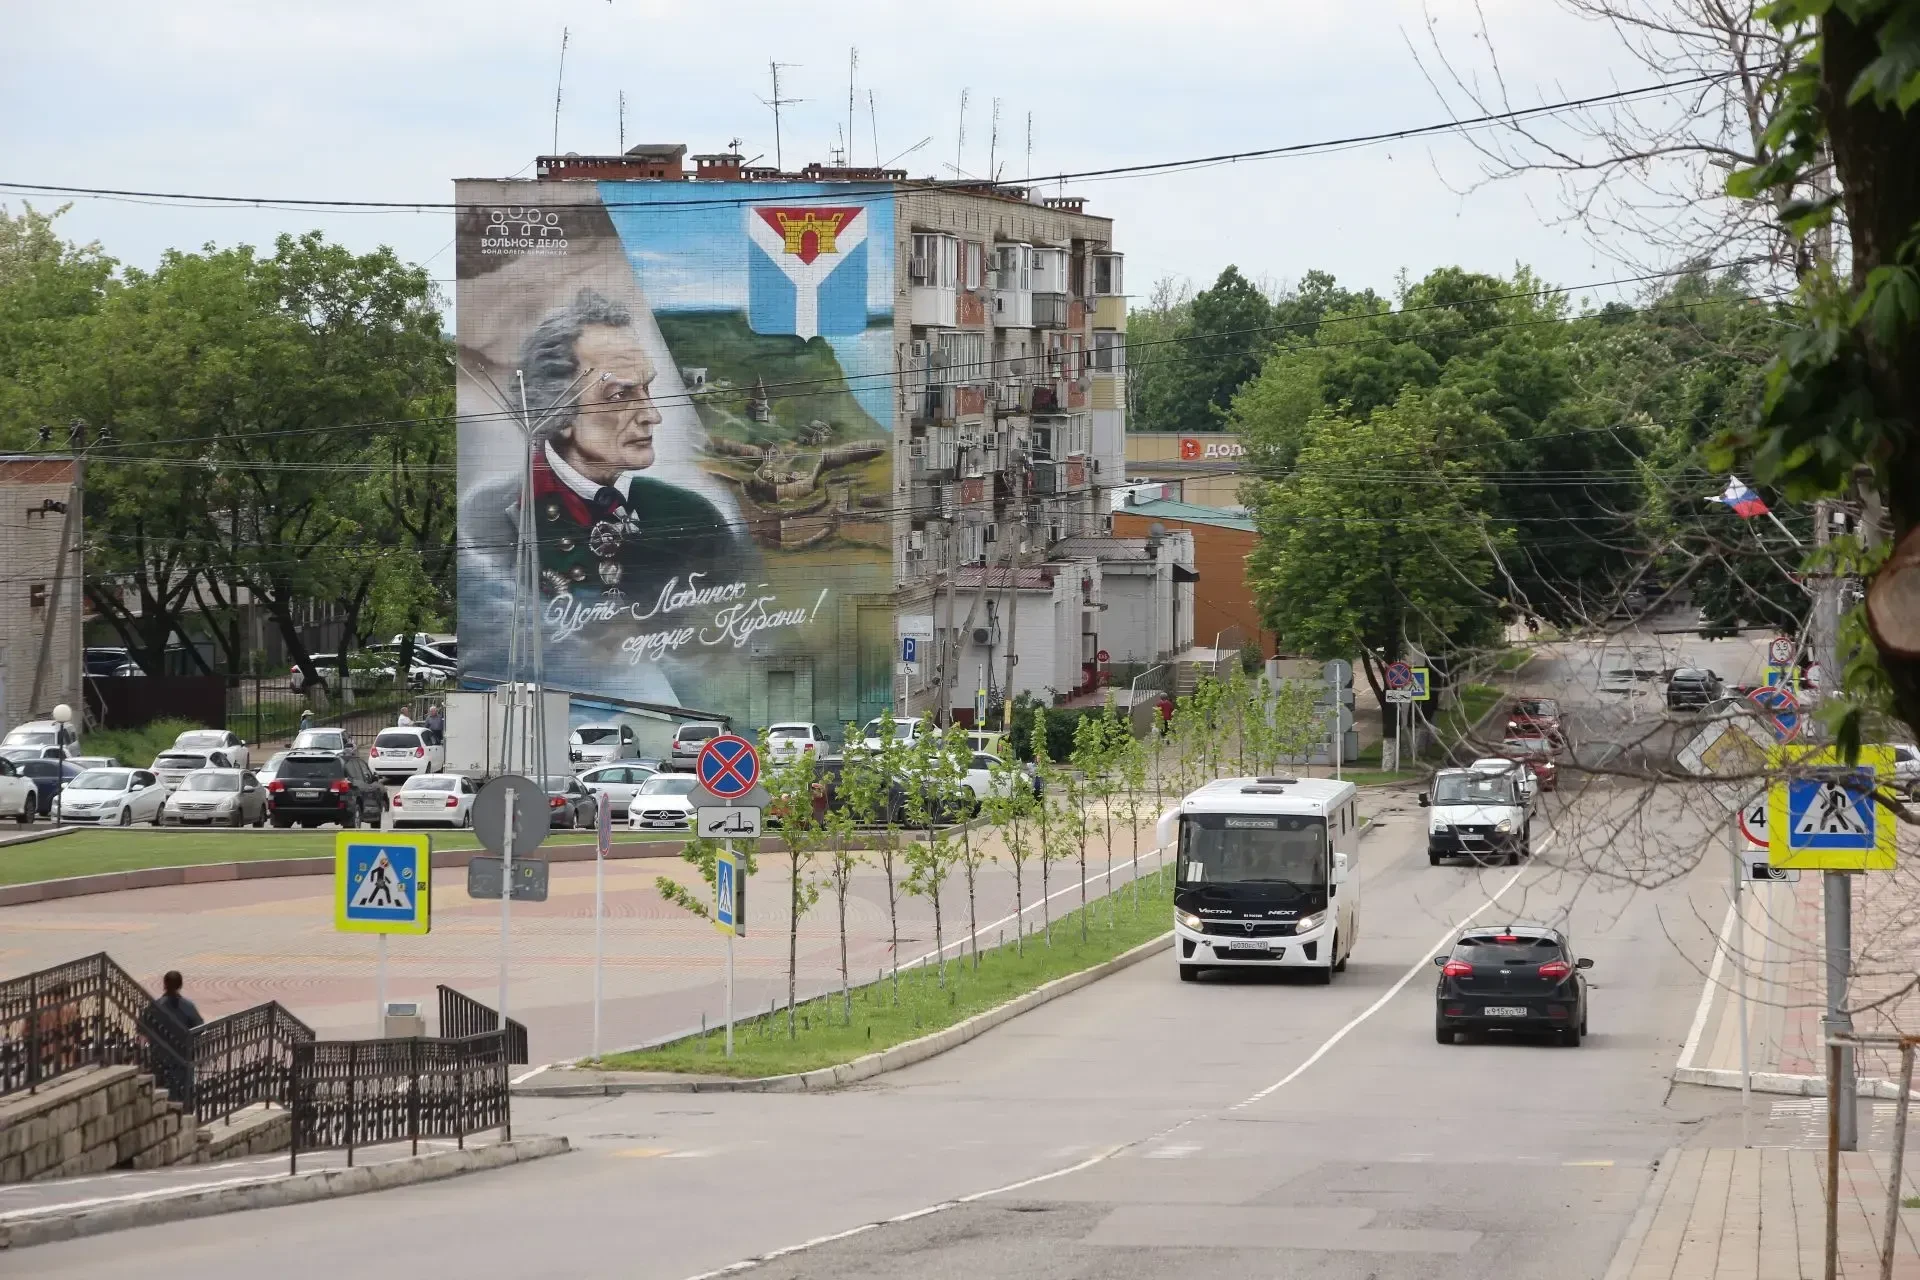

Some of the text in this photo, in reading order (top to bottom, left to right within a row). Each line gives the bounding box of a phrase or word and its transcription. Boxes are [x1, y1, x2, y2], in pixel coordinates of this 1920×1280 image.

[481, 238, 568, 248] ВОЛЬНОЕ ДЕЛО
[621, 626, 695, 666] сердце
[1749, 806, 1767, 828] 4
